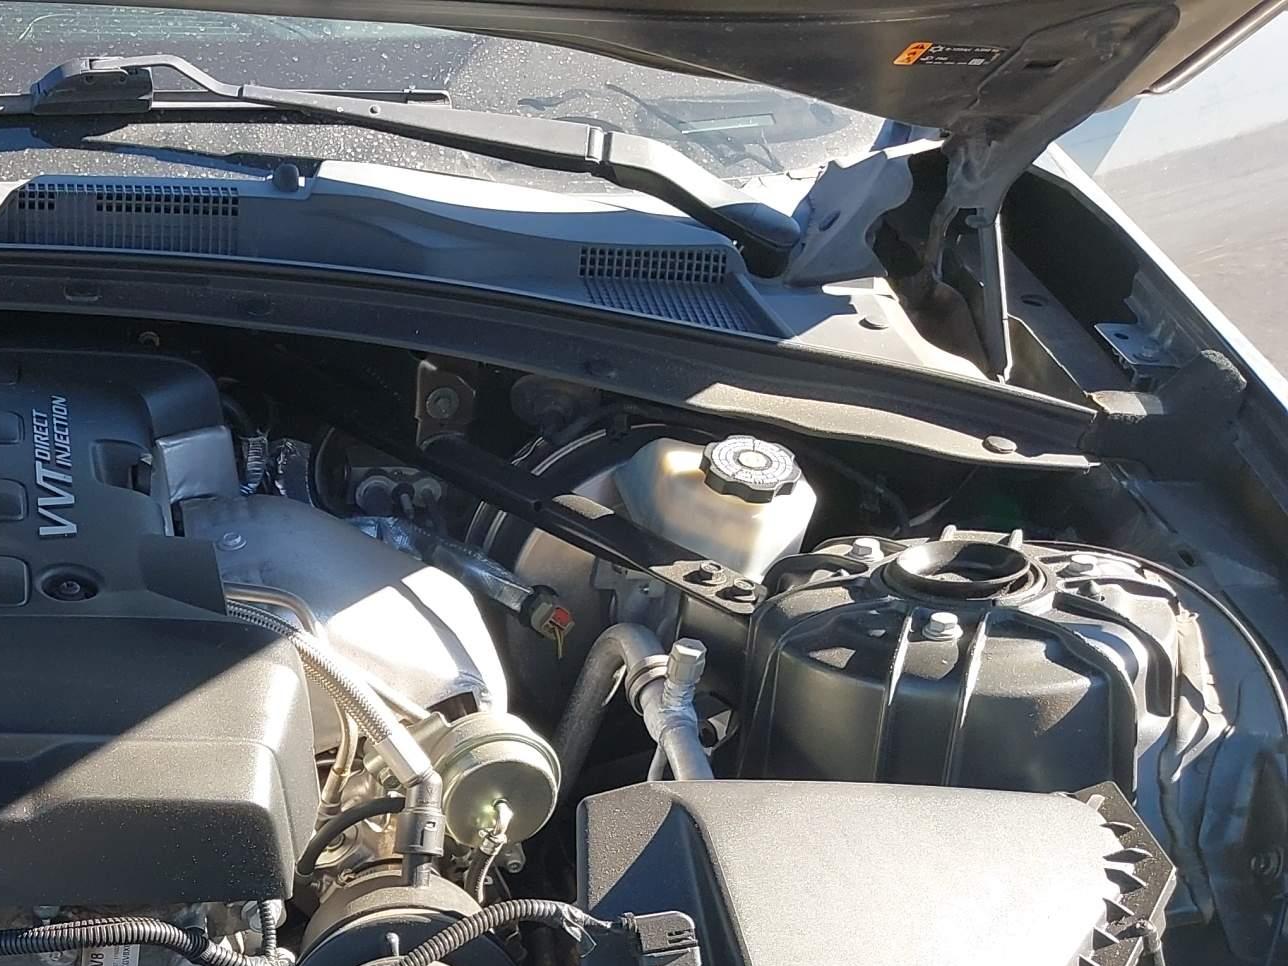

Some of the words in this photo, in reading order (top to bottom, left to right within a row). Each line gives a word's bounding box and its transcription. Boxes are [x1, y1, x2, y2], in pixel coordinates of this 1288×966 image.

[32, 408, 51, 461] DIRECT
[52, 396, 72, 467] INJECTION
[35, 460, 77, 536] VVT
